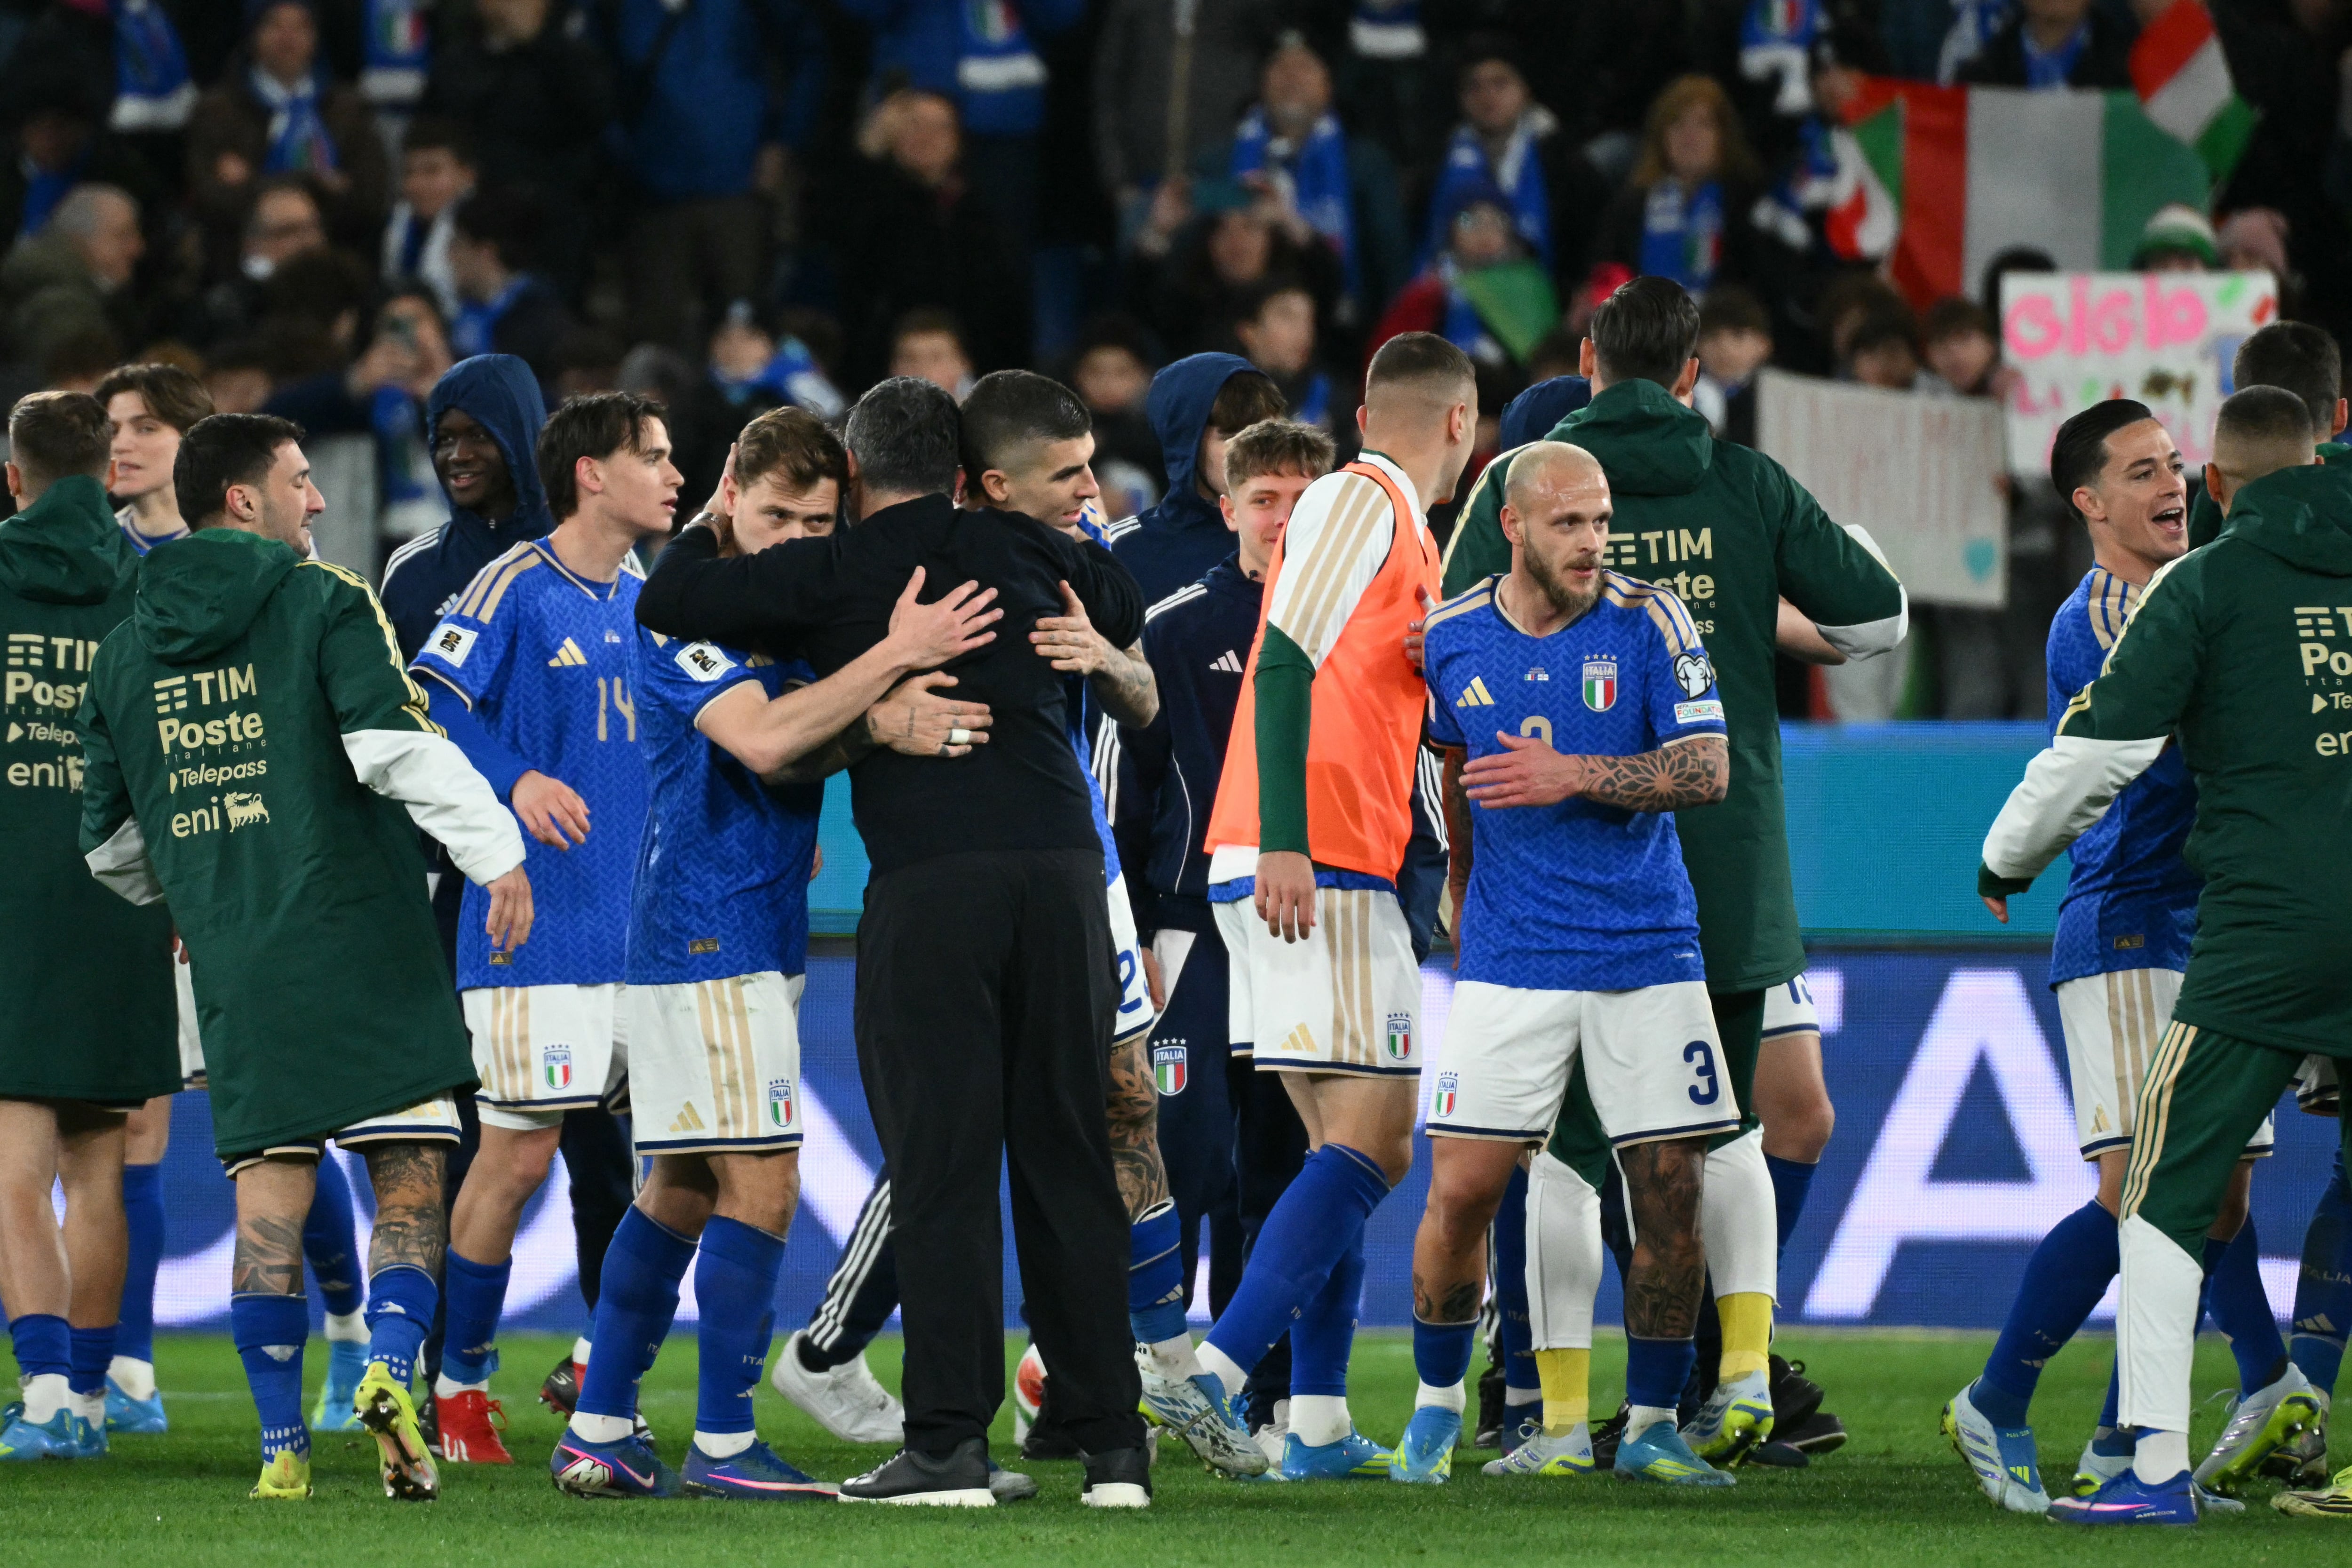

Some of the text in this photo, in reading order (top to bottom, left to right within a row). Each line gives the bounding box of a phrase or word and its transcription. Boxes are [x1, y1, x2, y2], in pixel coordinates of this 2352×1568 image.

[1641, 527, 1712, 564] TIM
[192, 662, 257, 705] TIM
[1585, 666, 1614, 676] ITALIA
[5, 706, 68, 718] itali
[597, 676, 636, 742] 14
[26, 722, 81, 748] Telep
[158, 710, 263, 755] Poste
[164, 738, 267, 765] italiane
[7, 755, 64, 787] eni
[178, 759, 267, 787] Telepass
[171, 796, 220, 838] eni
[1389, 1022, 1408, 1031] ITALIA
[1156, 1050, 1184, 1062] ITALIA
[1683, 1040, 1719, 1106] 3
[771, 1089, 789, 1098] ITALIA
